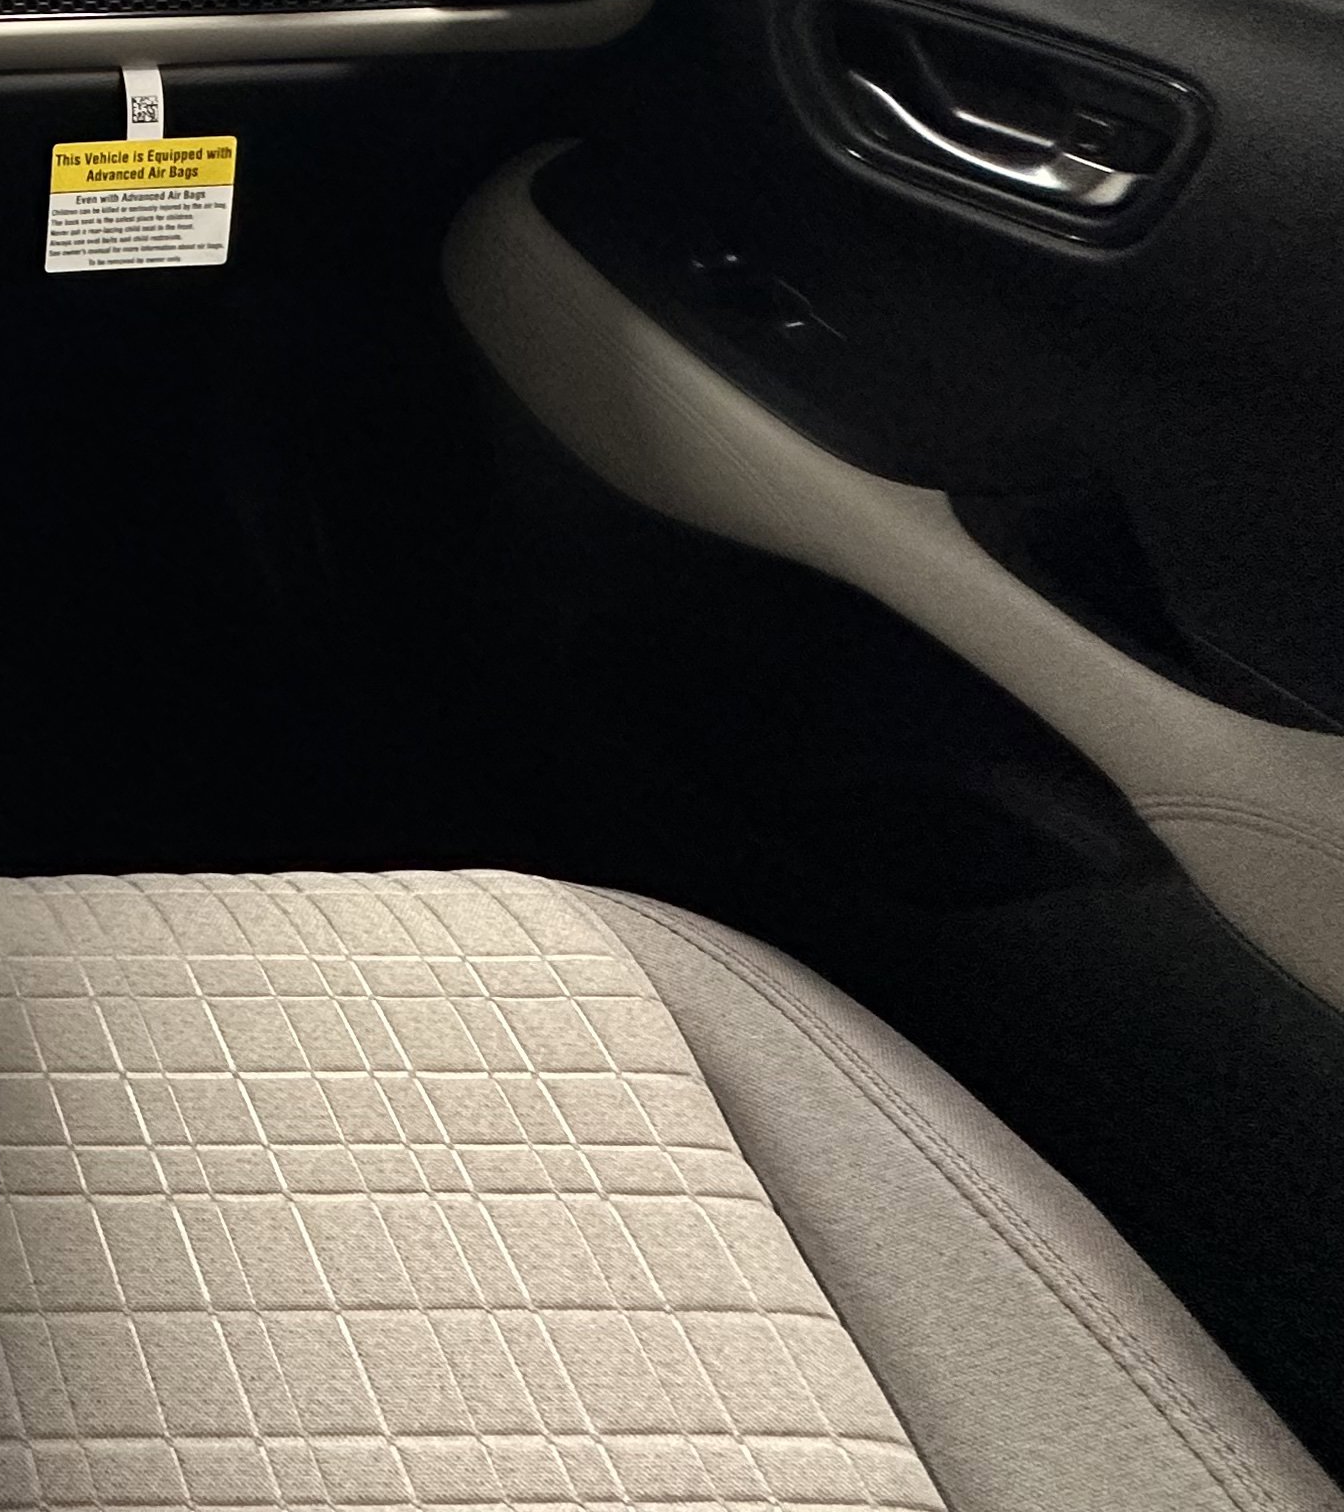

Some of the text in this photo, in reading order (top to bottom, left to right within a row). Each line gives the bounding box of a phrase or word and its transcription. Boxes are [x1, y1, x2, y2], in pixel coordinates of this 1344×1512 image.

[55, 146, 232, 167] This Vehicle is Equipped with
[86, 165, 199, 182] Advanced Air Bags
[76, 190, 206, 205] Even with Advanced Air Bags
